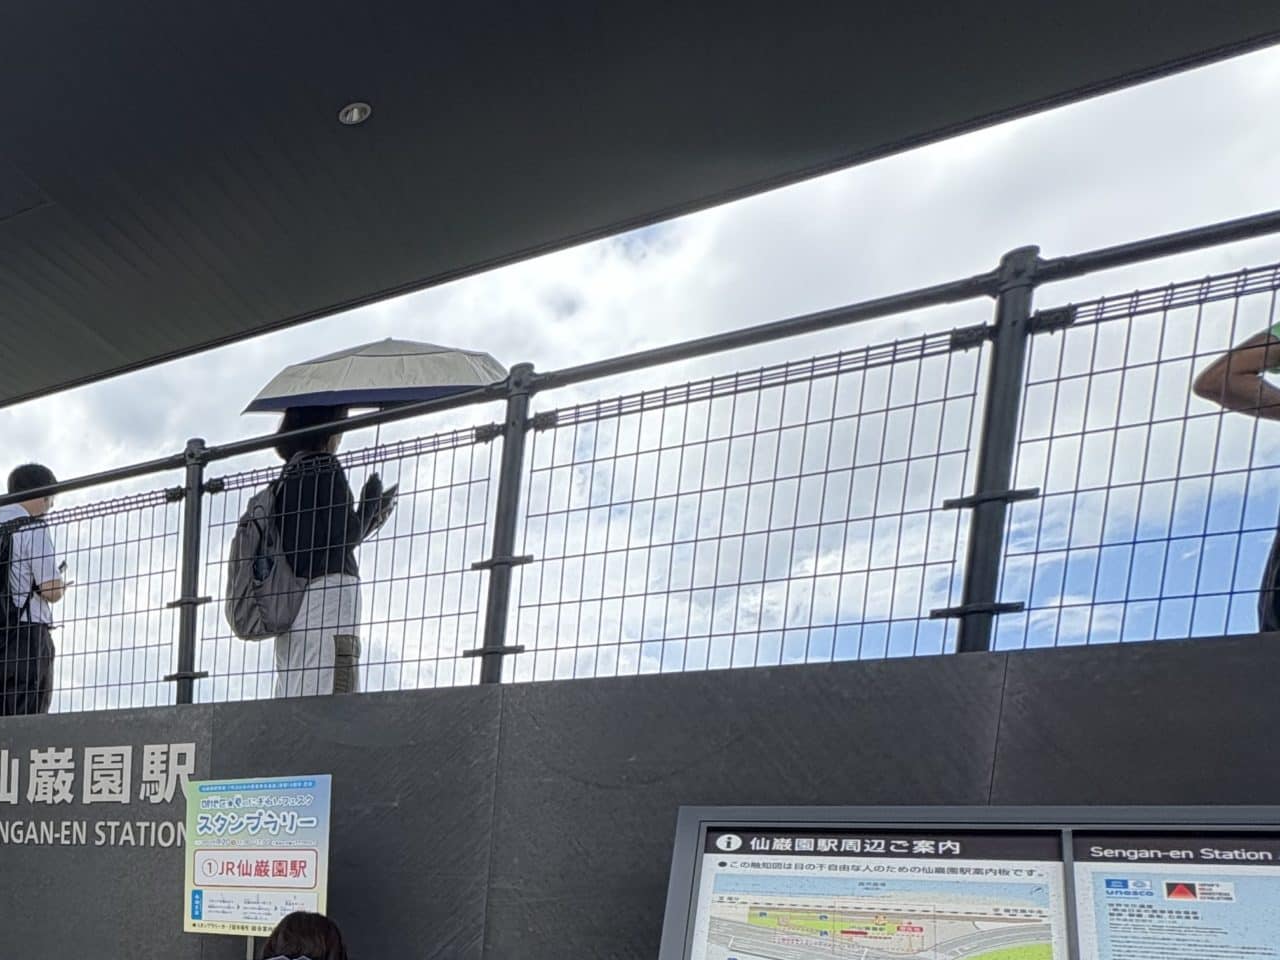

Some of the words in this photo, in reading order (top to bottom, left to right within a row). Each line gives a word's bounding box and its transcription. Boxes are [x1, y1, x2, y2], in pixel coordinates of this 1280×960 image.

[198, 809, 318, 836] スタンプラリー
[750, 837, 961, 855] 仙巌園駅周辺ご案内
[1090, 846, 1194, 861] Sengan-en
[1200, 847, 1273, 861] Station
